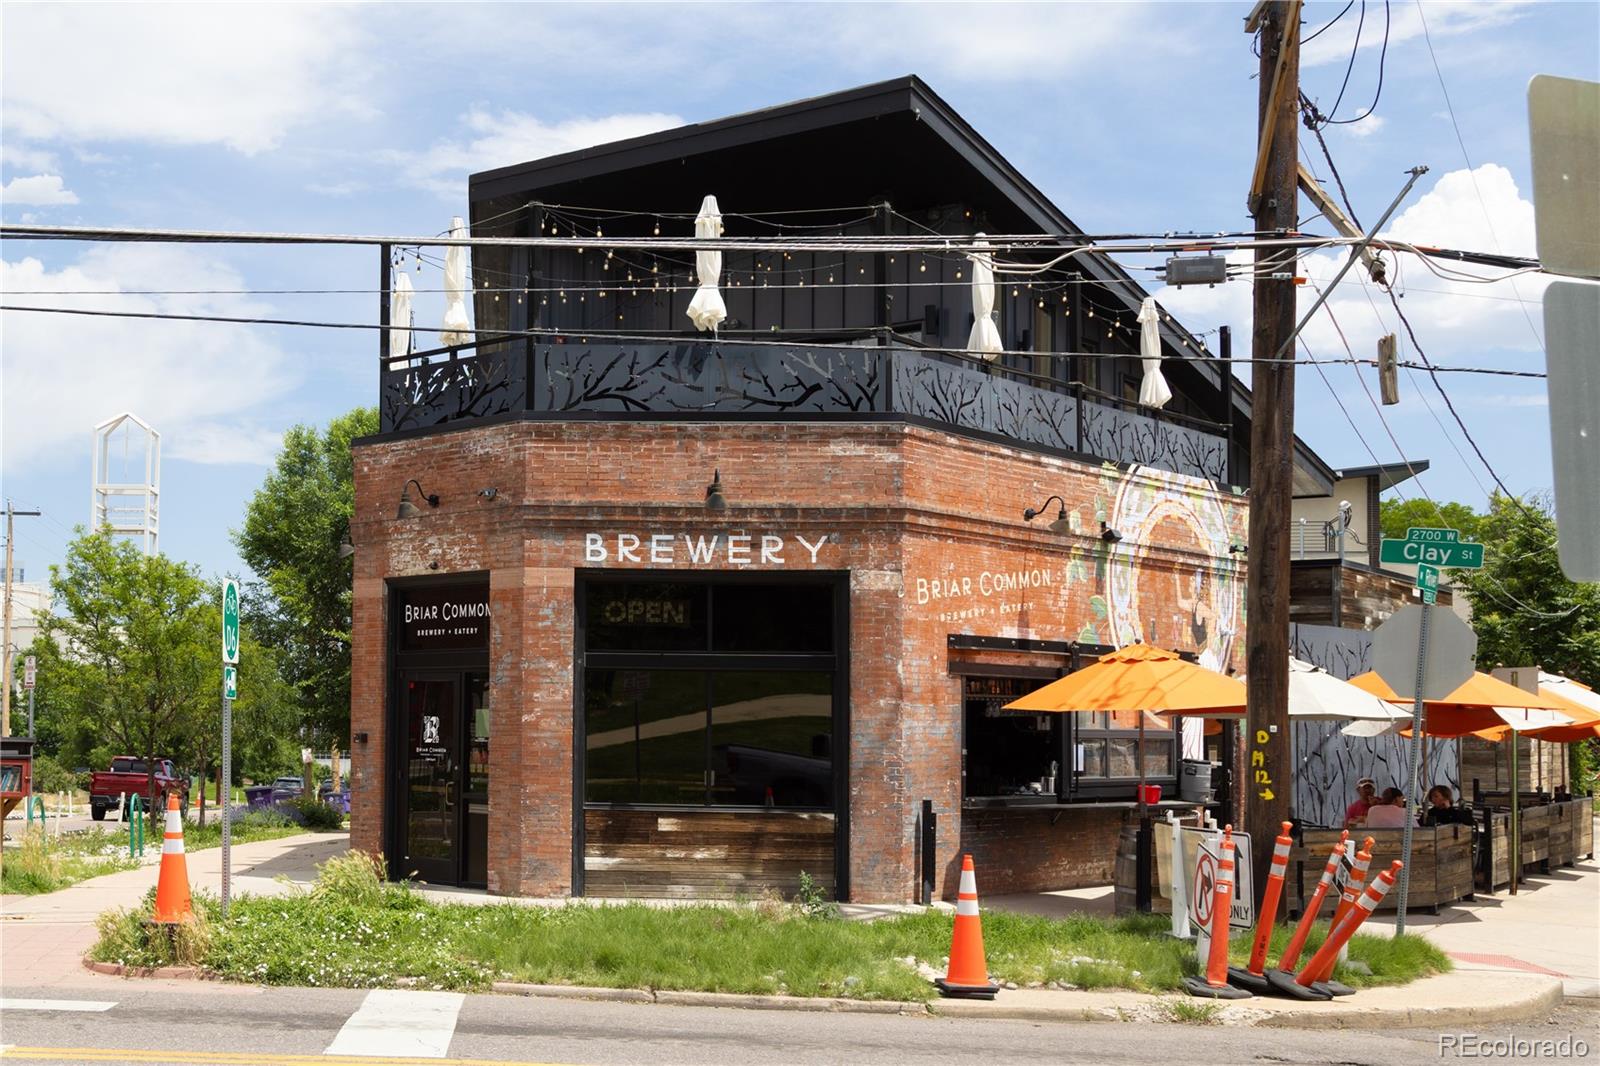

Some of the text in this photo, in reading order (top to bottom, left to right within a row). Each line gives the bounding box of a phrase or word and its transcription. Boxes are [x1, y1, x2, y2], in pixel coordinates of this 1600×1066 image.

[1412, 530, 1456, 541] 2700 W
[585, 533, 828, 564] BREWERY
[1403, 543, 1473, 565] Clay St
[916, 569, 1051, 605] BRIAR COMMON
[405, 602, 491, 623] BRIAR COMMON
[604, 600, 685, 624] OPEN
[940, 602, 1034, 622] BREWERY EATERY
[226, 624, 236, 652] D6
[417, 627, 478, 637] BREWERY EATERY
[1256, 730, 1270, 744] D
[1255, 770, 1272, 784] 12
